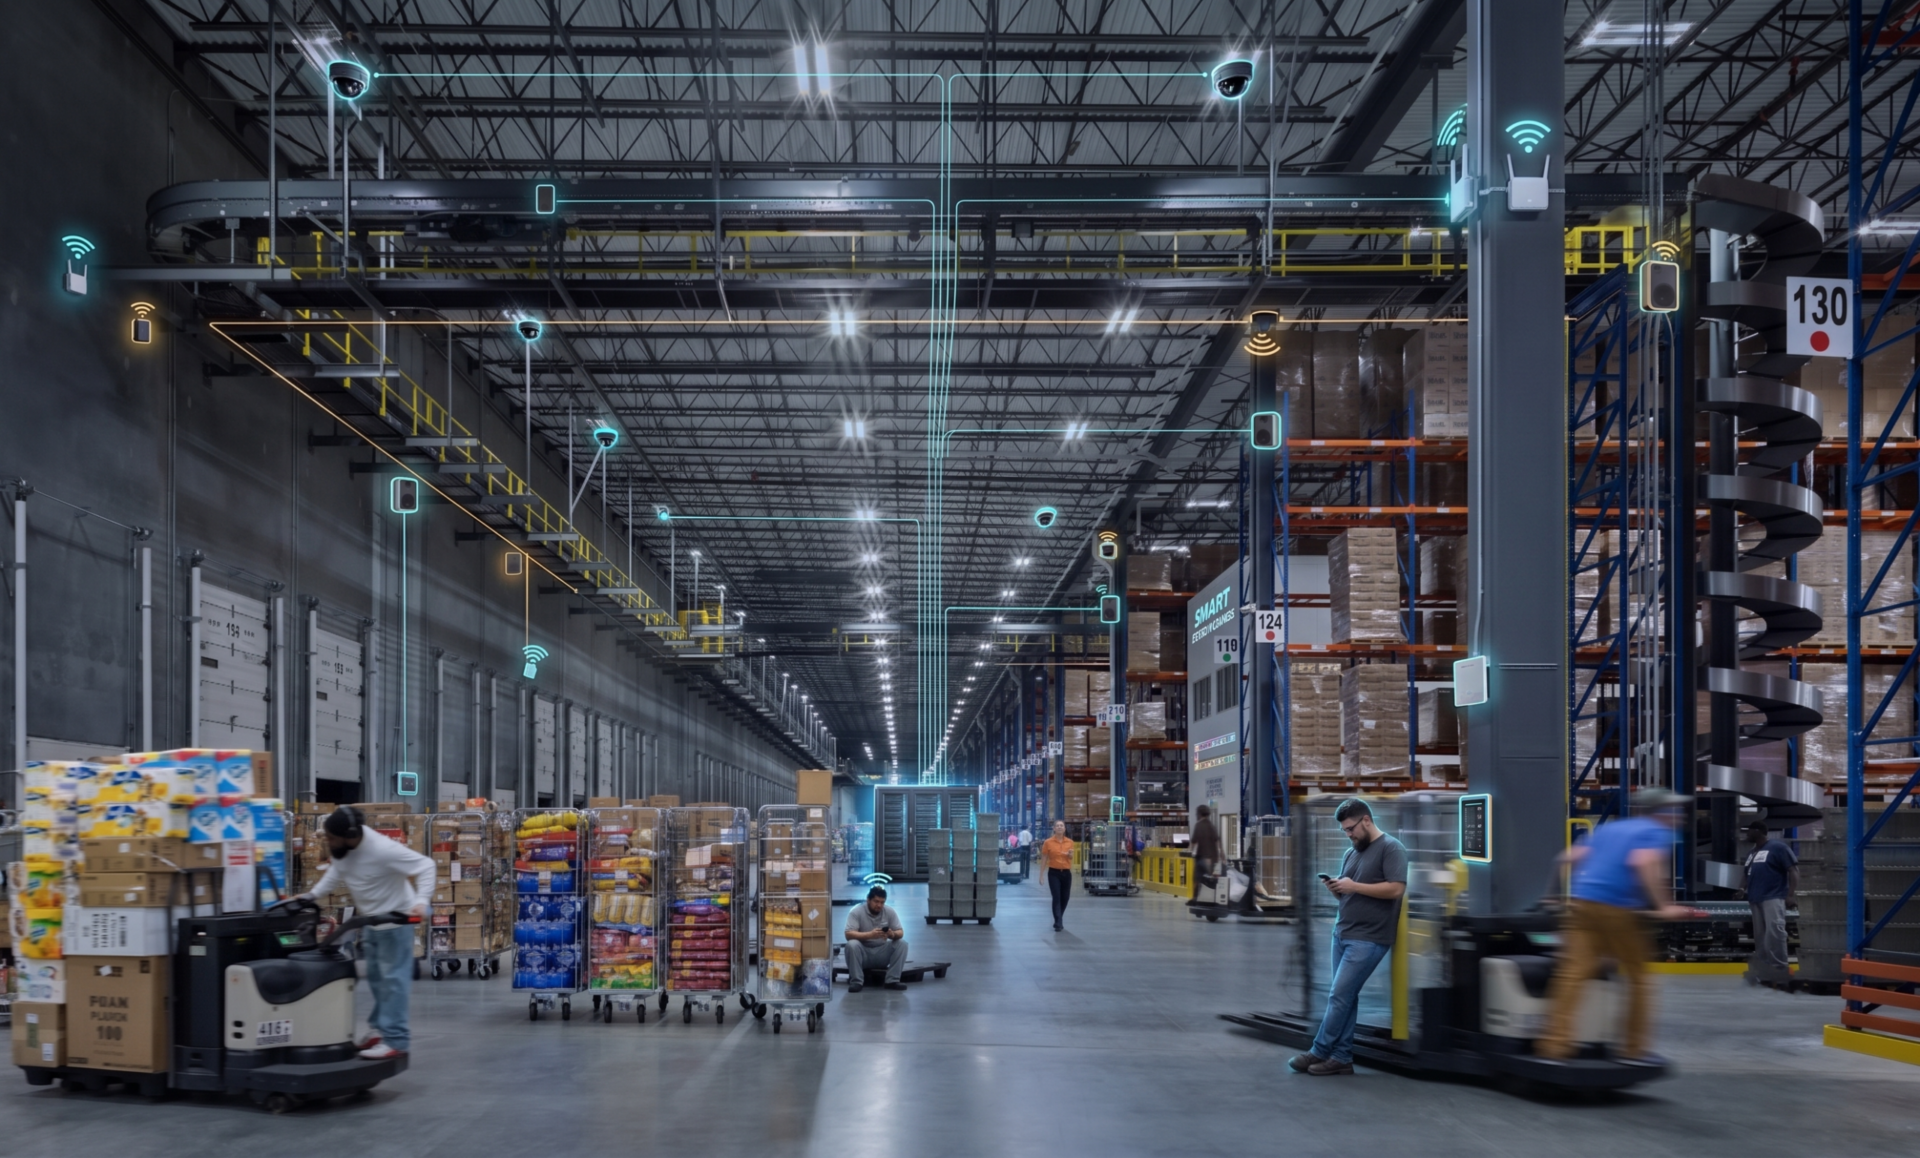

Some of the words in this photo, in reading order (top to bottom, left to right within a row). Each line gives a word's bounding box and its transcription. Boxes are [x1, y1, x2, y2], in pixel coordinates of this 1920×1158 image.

[1794, 285, 1847, 326] 130
[1195, 586, 1231, 628] SMART
[1259, 613, 1282, 630] 124
[1109, 706, 1124, 715] 210
